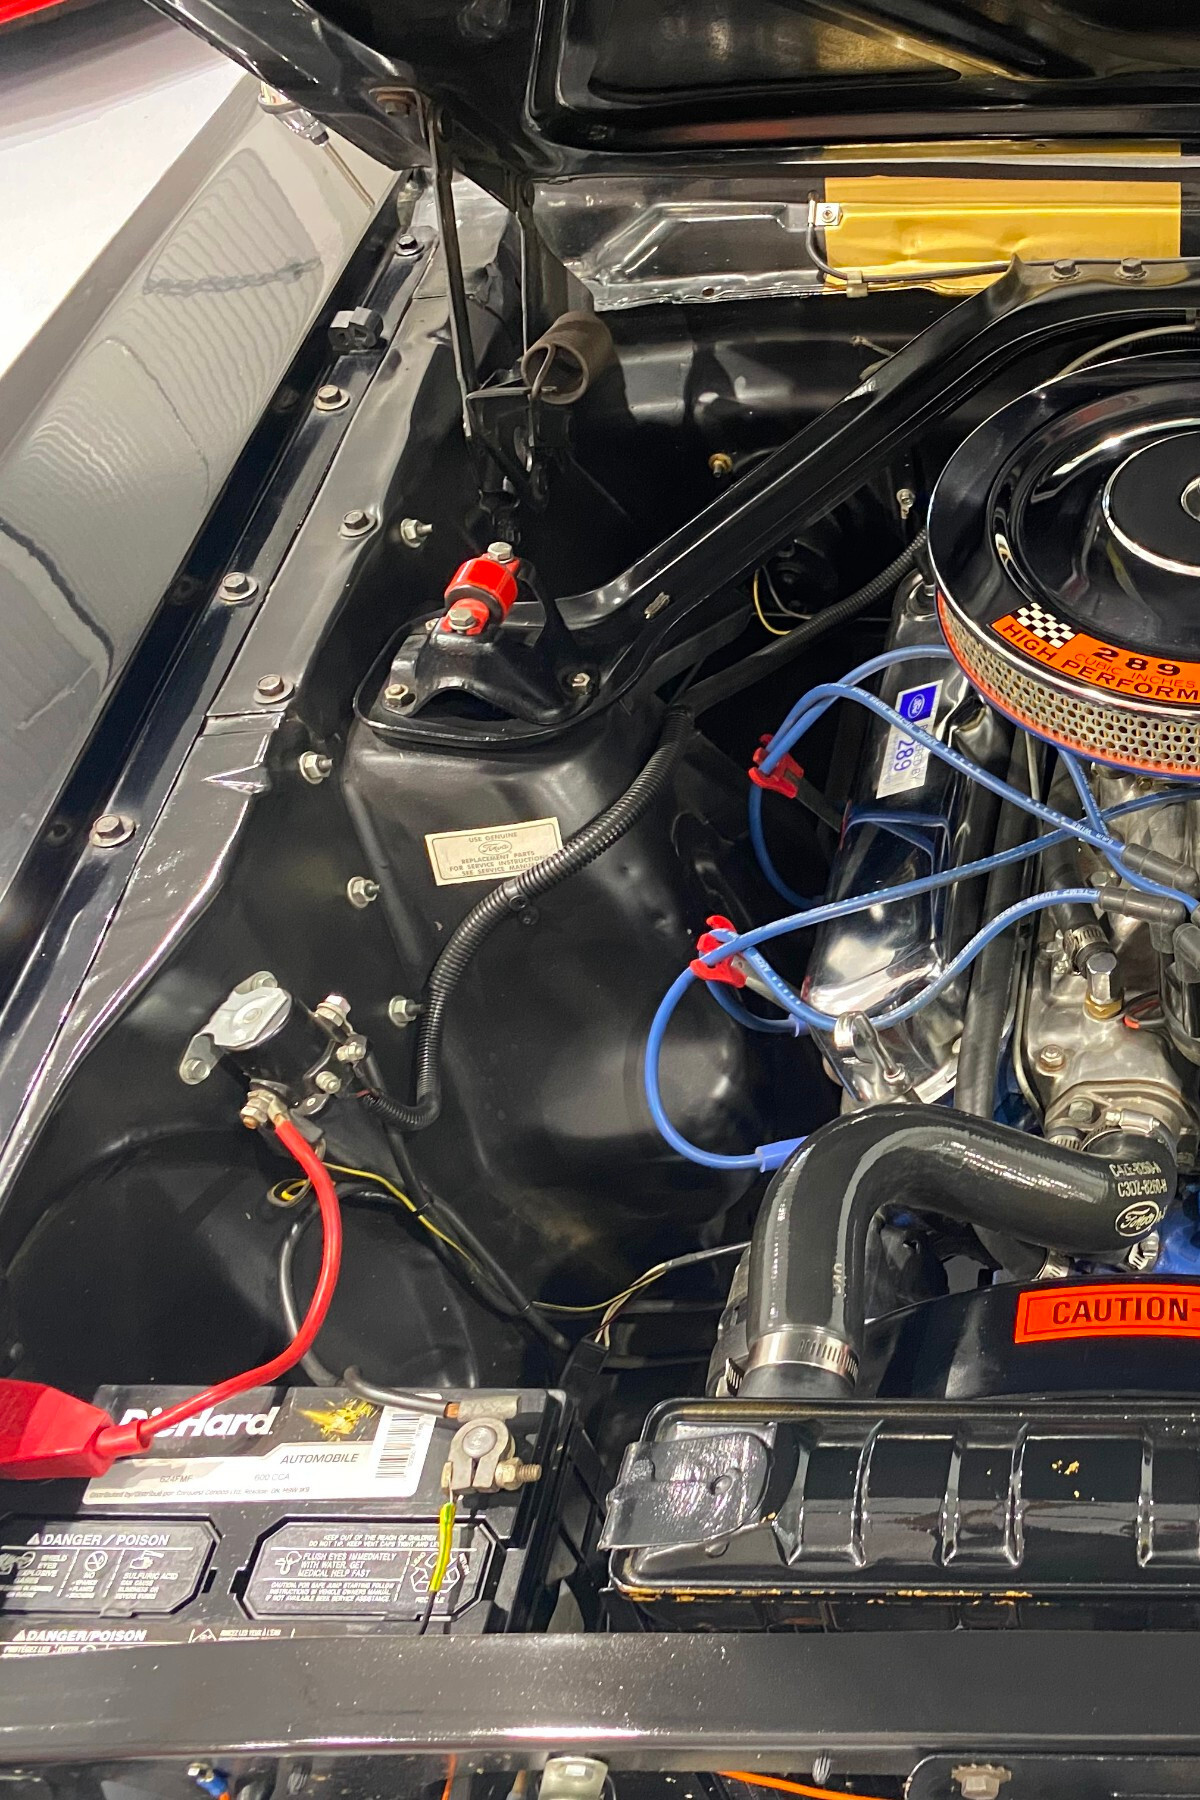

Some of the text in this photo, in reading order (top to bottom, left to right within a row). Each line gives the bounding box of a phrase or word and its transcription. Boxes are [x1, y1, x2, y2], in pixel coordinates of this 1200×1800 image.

[1002, 623, 1058, 661] HIGH
[1093, 646, 1181, 676] 289
[1074, 652, 1195, 688] CUBIC INCHES
[912, 723, 929, 767] PERED
[894, 739, 915, 772] 289
[485, 832, 518, 841] GENUINE
[461, 850, 535, 864] REPLACEMENT PARTS
[467, 861, 494, 870] SERVICE
[477, 866, 505, 875] SERVICE
[280, 1453, 360, 1465] AUTOMOBILE
[254, 1473, 290, 1482] 600 CCA
[41, 1534, 102, 1546] DANGER
[116, 1534, 171, 1546] POISON
[300, 1561, 320, 1569] WITH
[83, 1571, 96, 1579] NO
[123, 1572, 179, 1580] SULFURIC ACID
[298, 1569, 371, 1577] MEDICAL HELP FAST
[26, 1629, 148, 1642] DANGER/POISON
